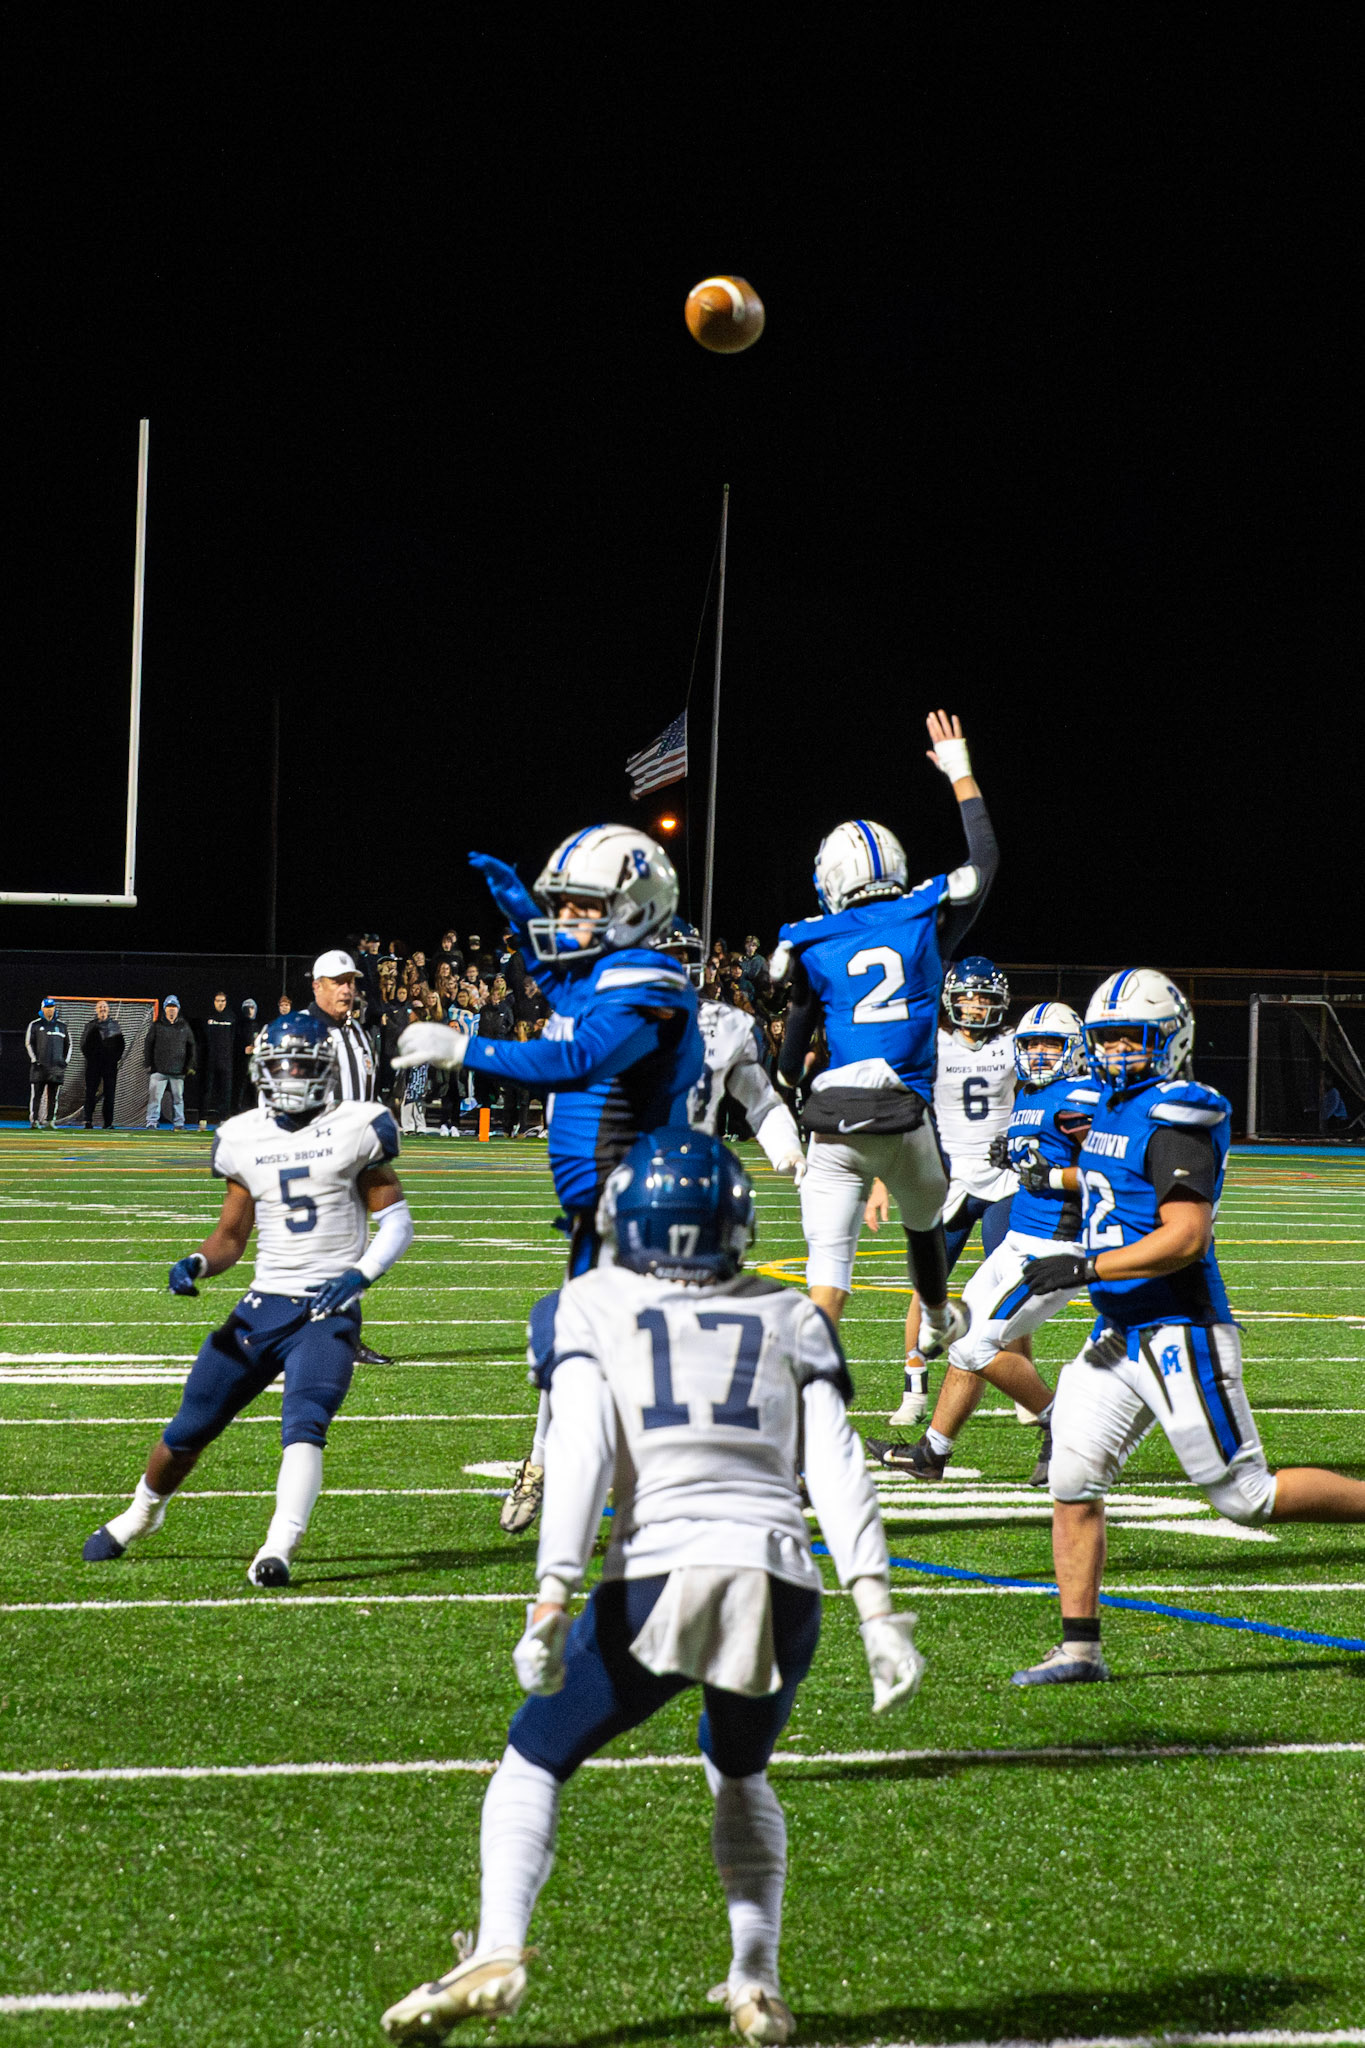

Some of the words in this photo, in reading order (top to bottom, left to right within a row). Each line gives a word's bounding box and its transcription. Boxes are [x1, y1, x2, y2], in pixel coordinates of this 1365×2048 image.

[847, 945, 909, 1024] 2
[945, 1066, 972, 1075] MOSES
[976, 1063, 1006, 1074] BROWN
[963, 1076, 989, 1121] 6
[255, 1153, 289, 1165] MOSES
[294, 1147, 333, 1161] BROWN
[279, 1166, 317, 1233] 5
[668, 1224, 700, 1258] 17
[636, 1308, 764, 1430] 17
